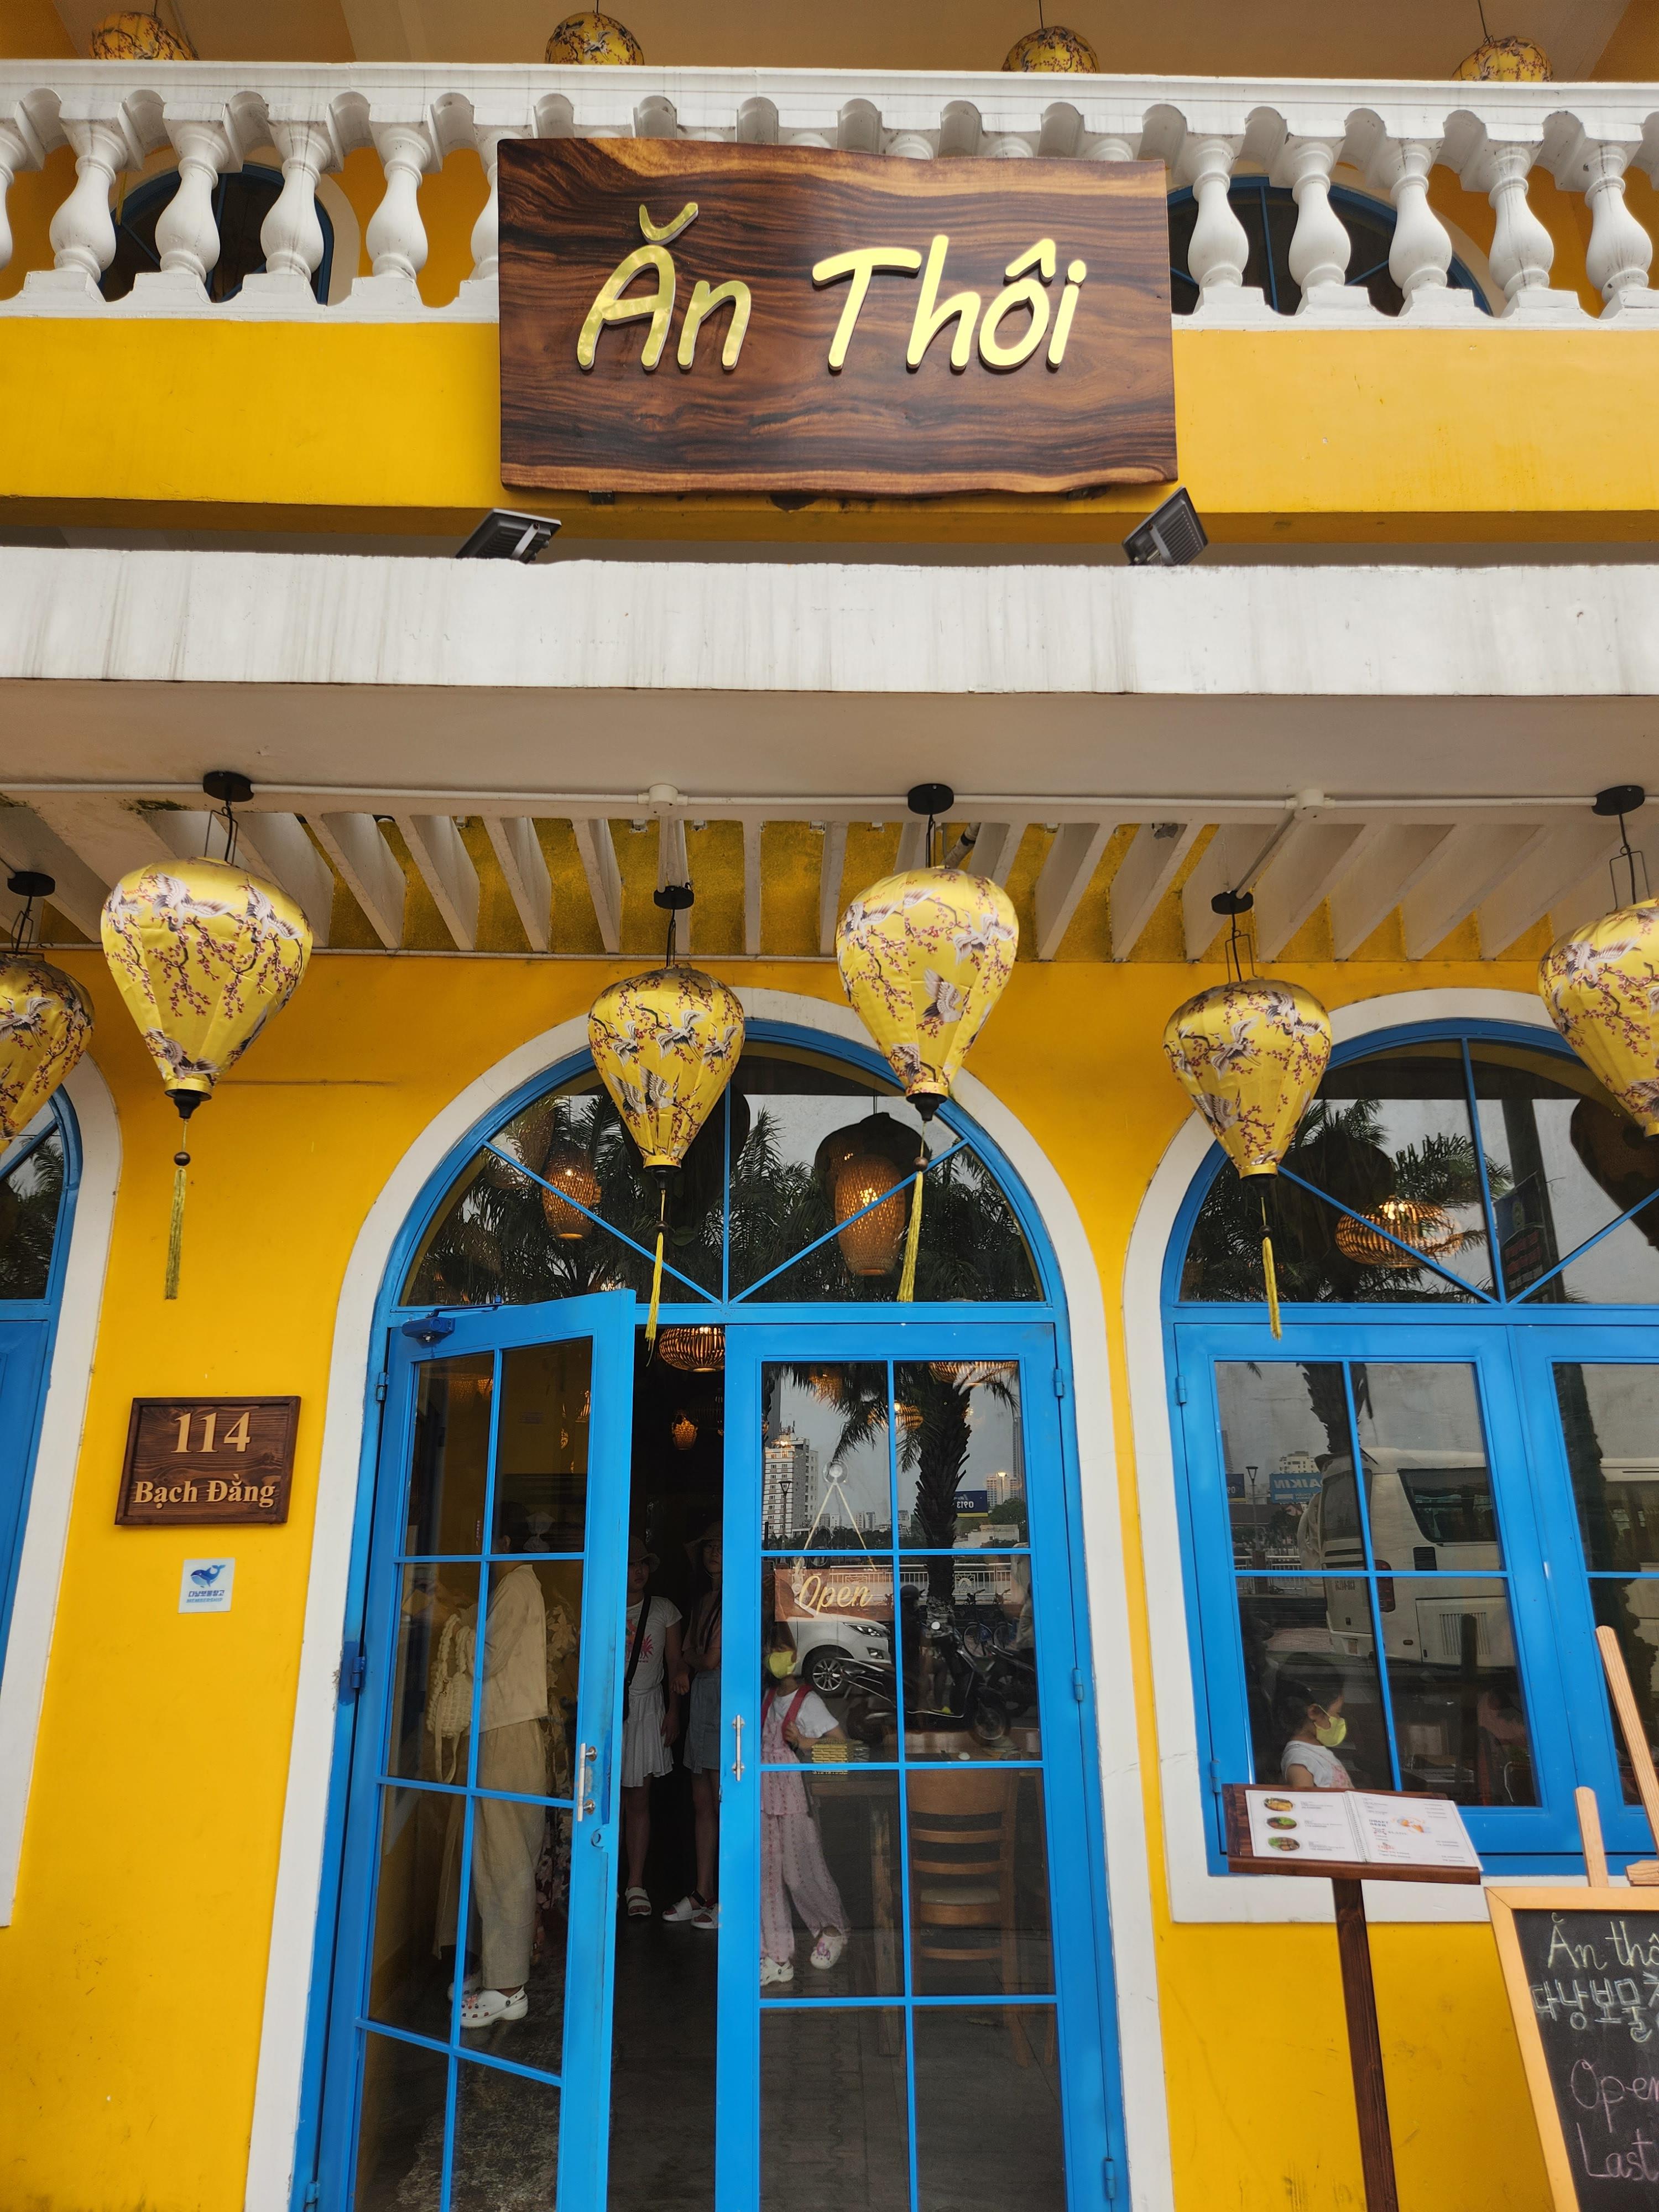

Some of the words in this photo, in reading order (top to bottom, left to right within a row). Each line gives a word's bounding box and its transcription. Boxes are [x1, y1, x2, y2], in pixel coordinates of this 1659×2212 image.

[577, 202, 752, 373] Ăn
[812, 234, 1088, 373] Thôi
[171, 1412, 252, 1453] 114
[132, 1480, 198, 1509] Bạch
[205, 1473, 276, 1508] Đằng
[799, 1575, 873, 1616] Open
[1576, 2122, 1659, 2182] Last
